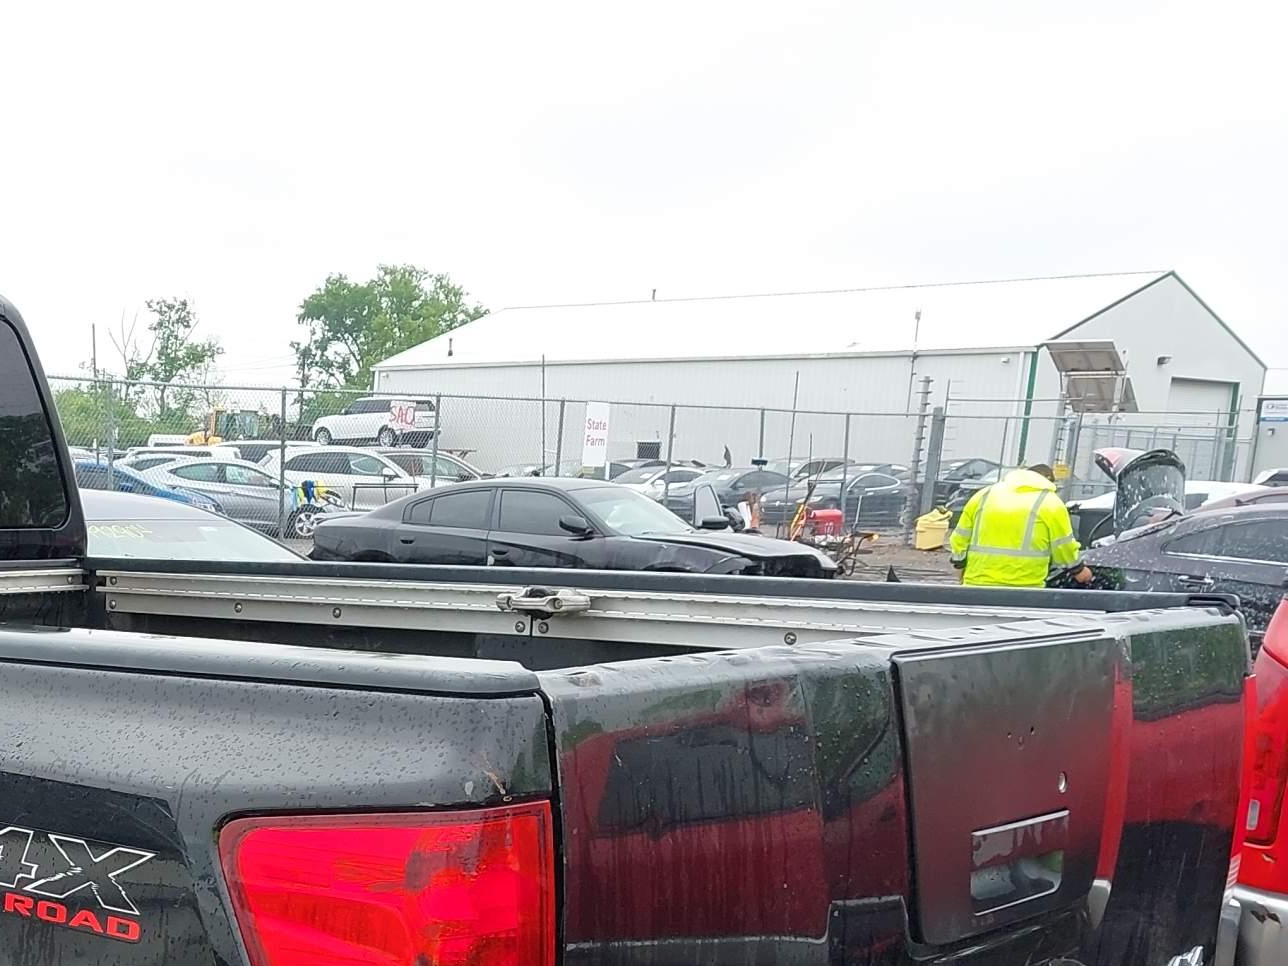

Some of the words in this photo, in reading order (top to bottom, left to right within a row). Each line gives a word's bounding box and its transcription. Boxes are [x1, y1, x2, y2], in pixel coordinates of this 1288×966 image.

[587, 418, 607, 431] State
[585, 435, 606, 447] Farm
[4, 893, 142, 942] ROAD
